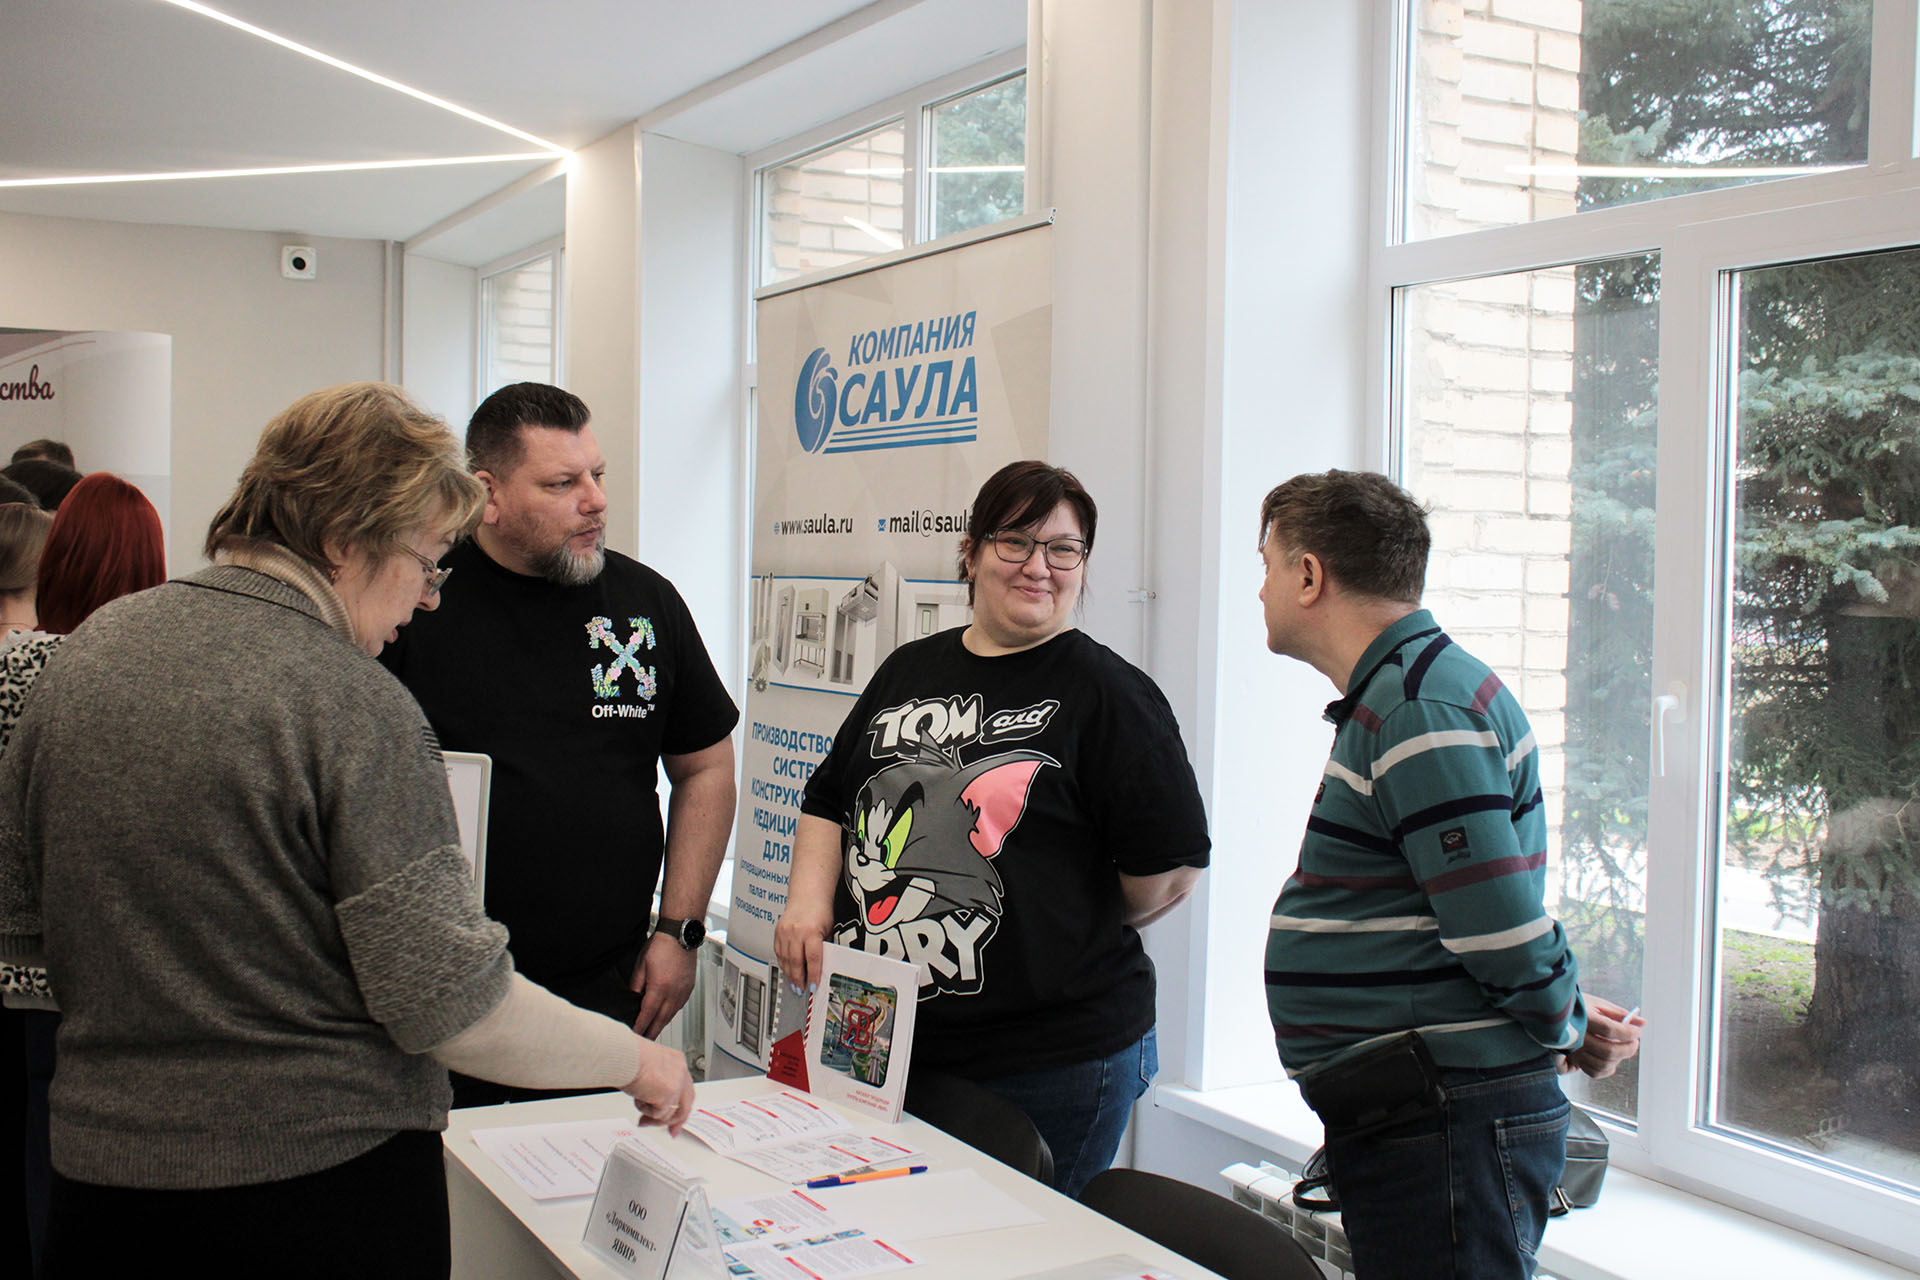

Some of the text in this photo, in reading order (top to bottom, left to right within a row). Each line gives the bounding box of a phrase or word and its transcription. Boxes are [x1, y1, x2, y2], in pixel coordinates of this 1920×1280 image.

[848, 311, 976, 367] КОМПАНИЯ
[0, 364, 55, 400] ства
[839, 356, 977, 427] САУЛА
[781, 510, 971, 537] www.saula.ru mail@saul
[875, 699, 1054, 748] TOM and
[752, 722, 833, 755] ПРОИЗВОДСТВО
[773, 756, 818, 780] СИСТЕ
[753, 806, 797, 837] МЕДИЦИ
[763, 839, 790, 864] ДЛЯ
[740, 858, 789, 886] операционных
[749, 883, 787, 904] палат инте
[628, 1199, 648, 1221] ООО
